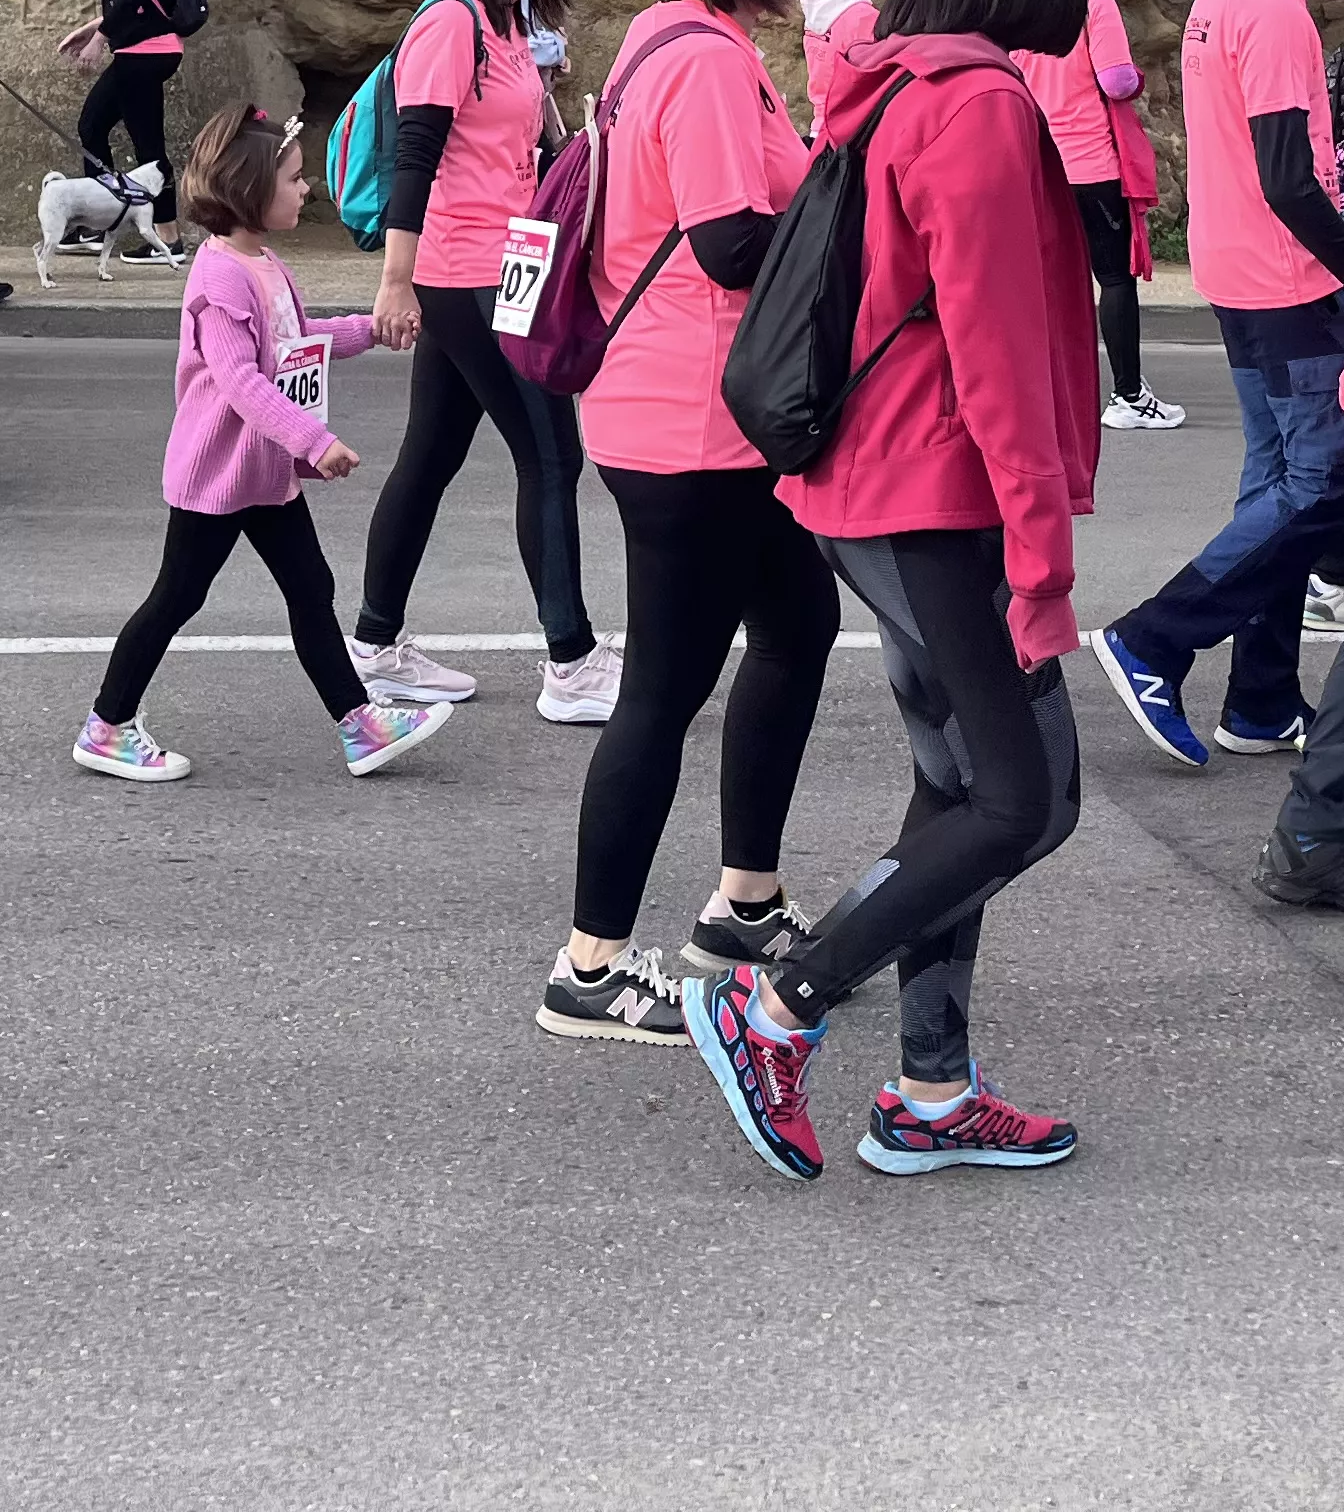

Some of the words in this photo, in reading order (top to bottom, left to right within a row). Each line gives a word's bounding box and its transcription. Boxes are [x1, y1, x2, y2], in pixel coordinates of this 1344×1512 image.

[1132, 672, 1170, 706] N
[761, 930, 795, 961] N
[606, 986, 656, 1027] N
[764, 1057, 783, 1105] Columbia
